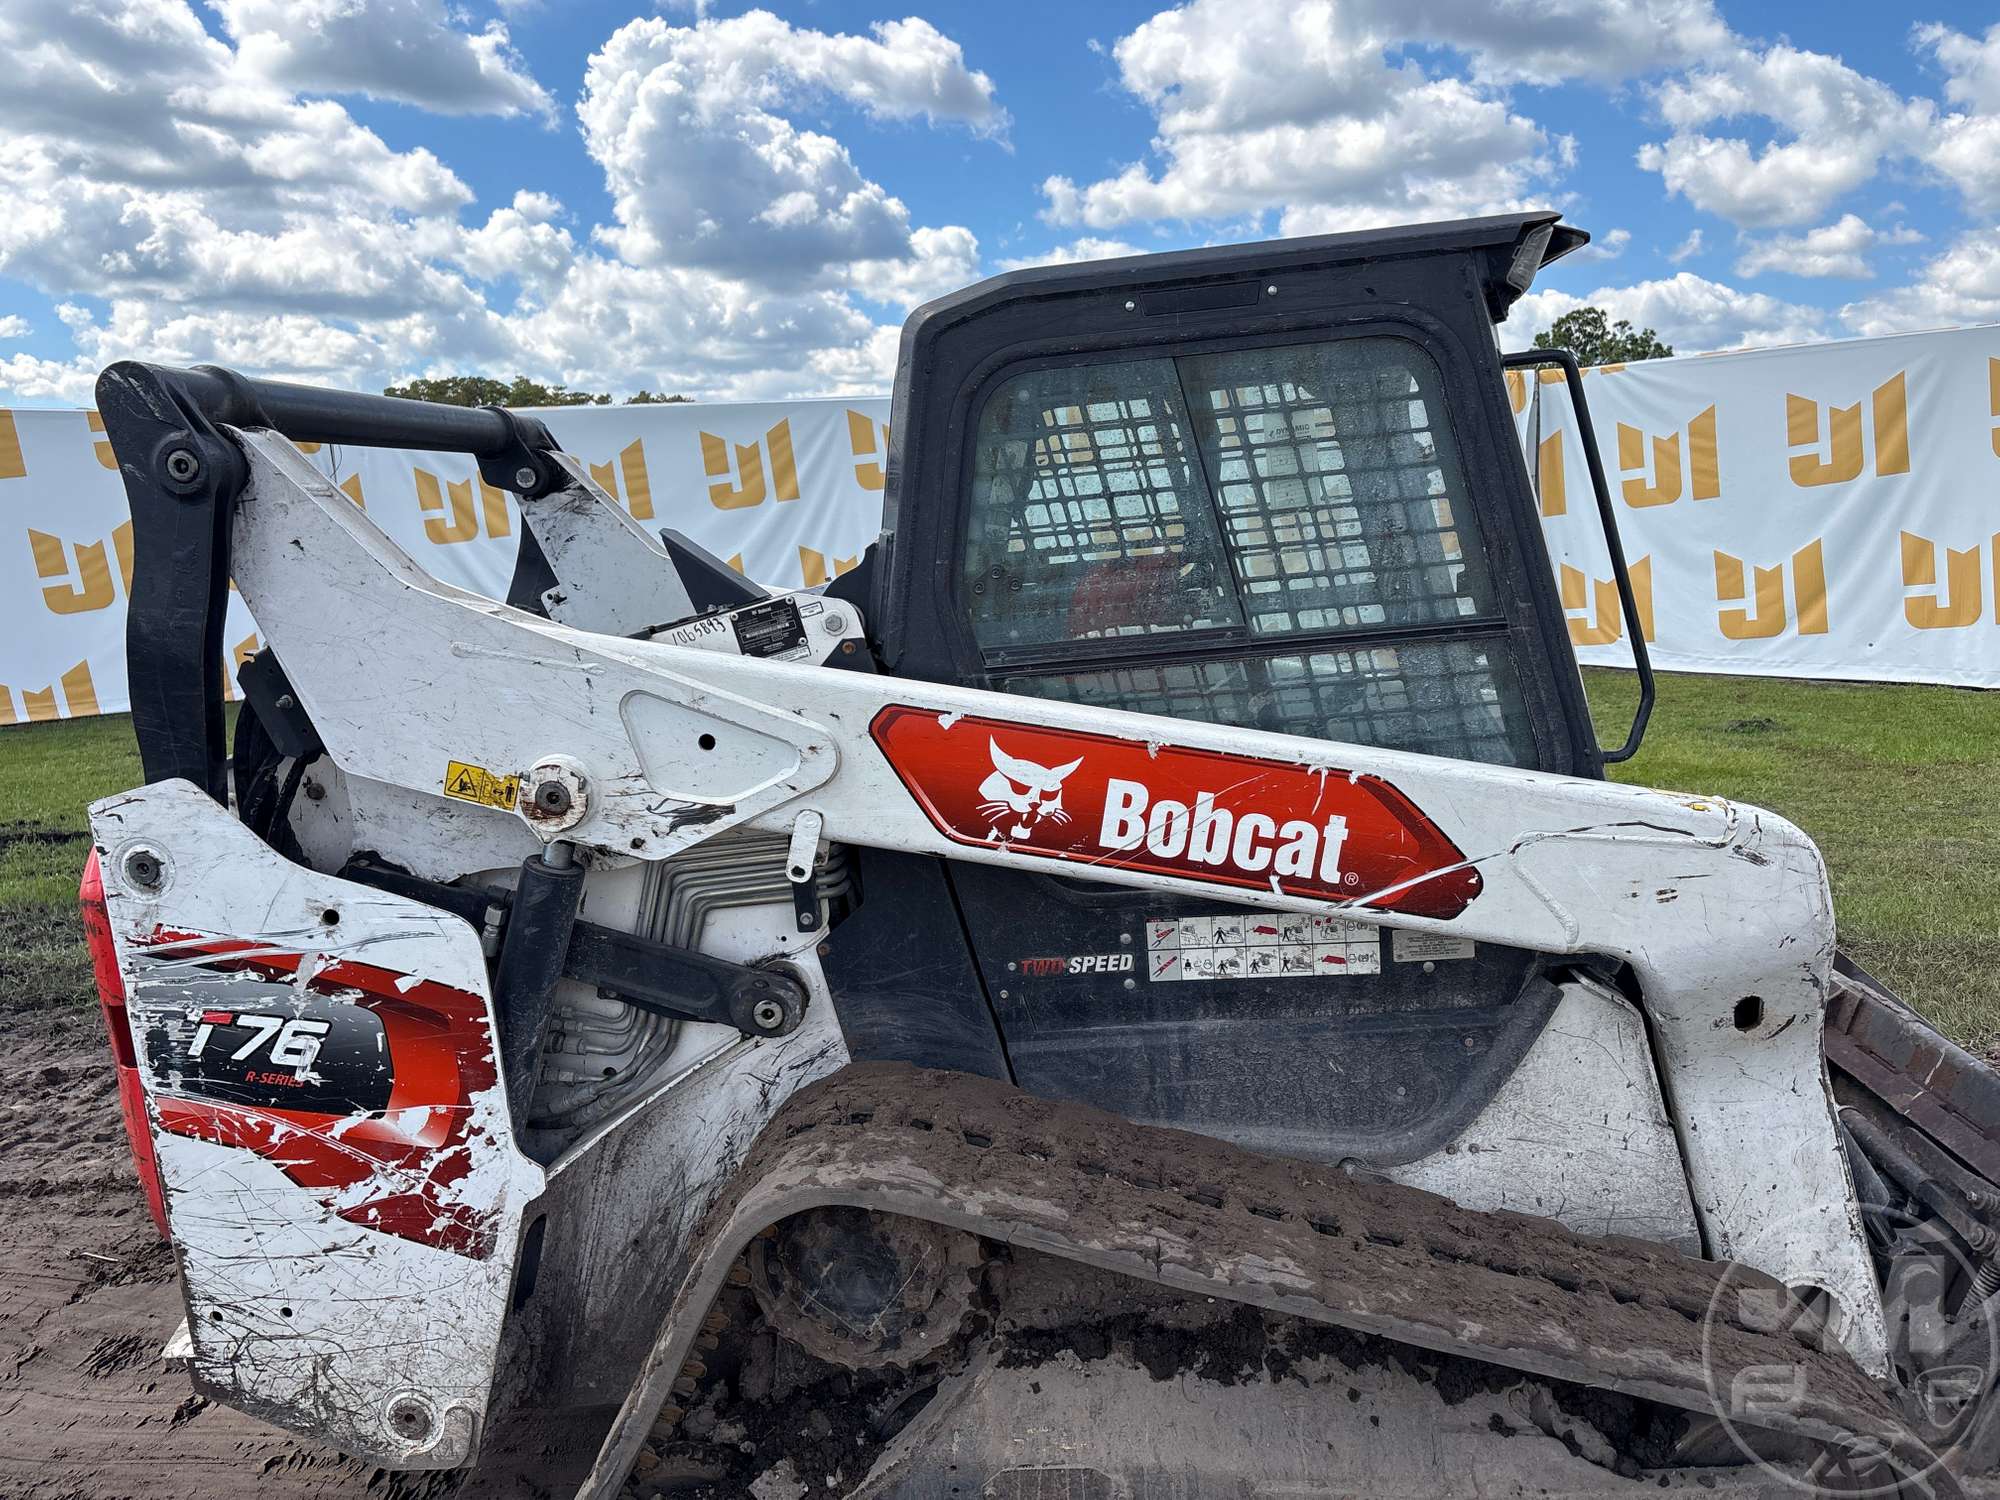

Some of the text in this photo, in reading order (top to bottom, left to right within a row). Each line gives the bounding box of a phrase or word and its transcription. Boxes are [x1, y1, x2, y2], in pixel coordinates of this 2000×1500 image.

[1275, 423, 1310, 435] DYNMIC
[1099, 778, 1348, 884] Bobcat
[1069, 954, 1133, 974] SPEED
